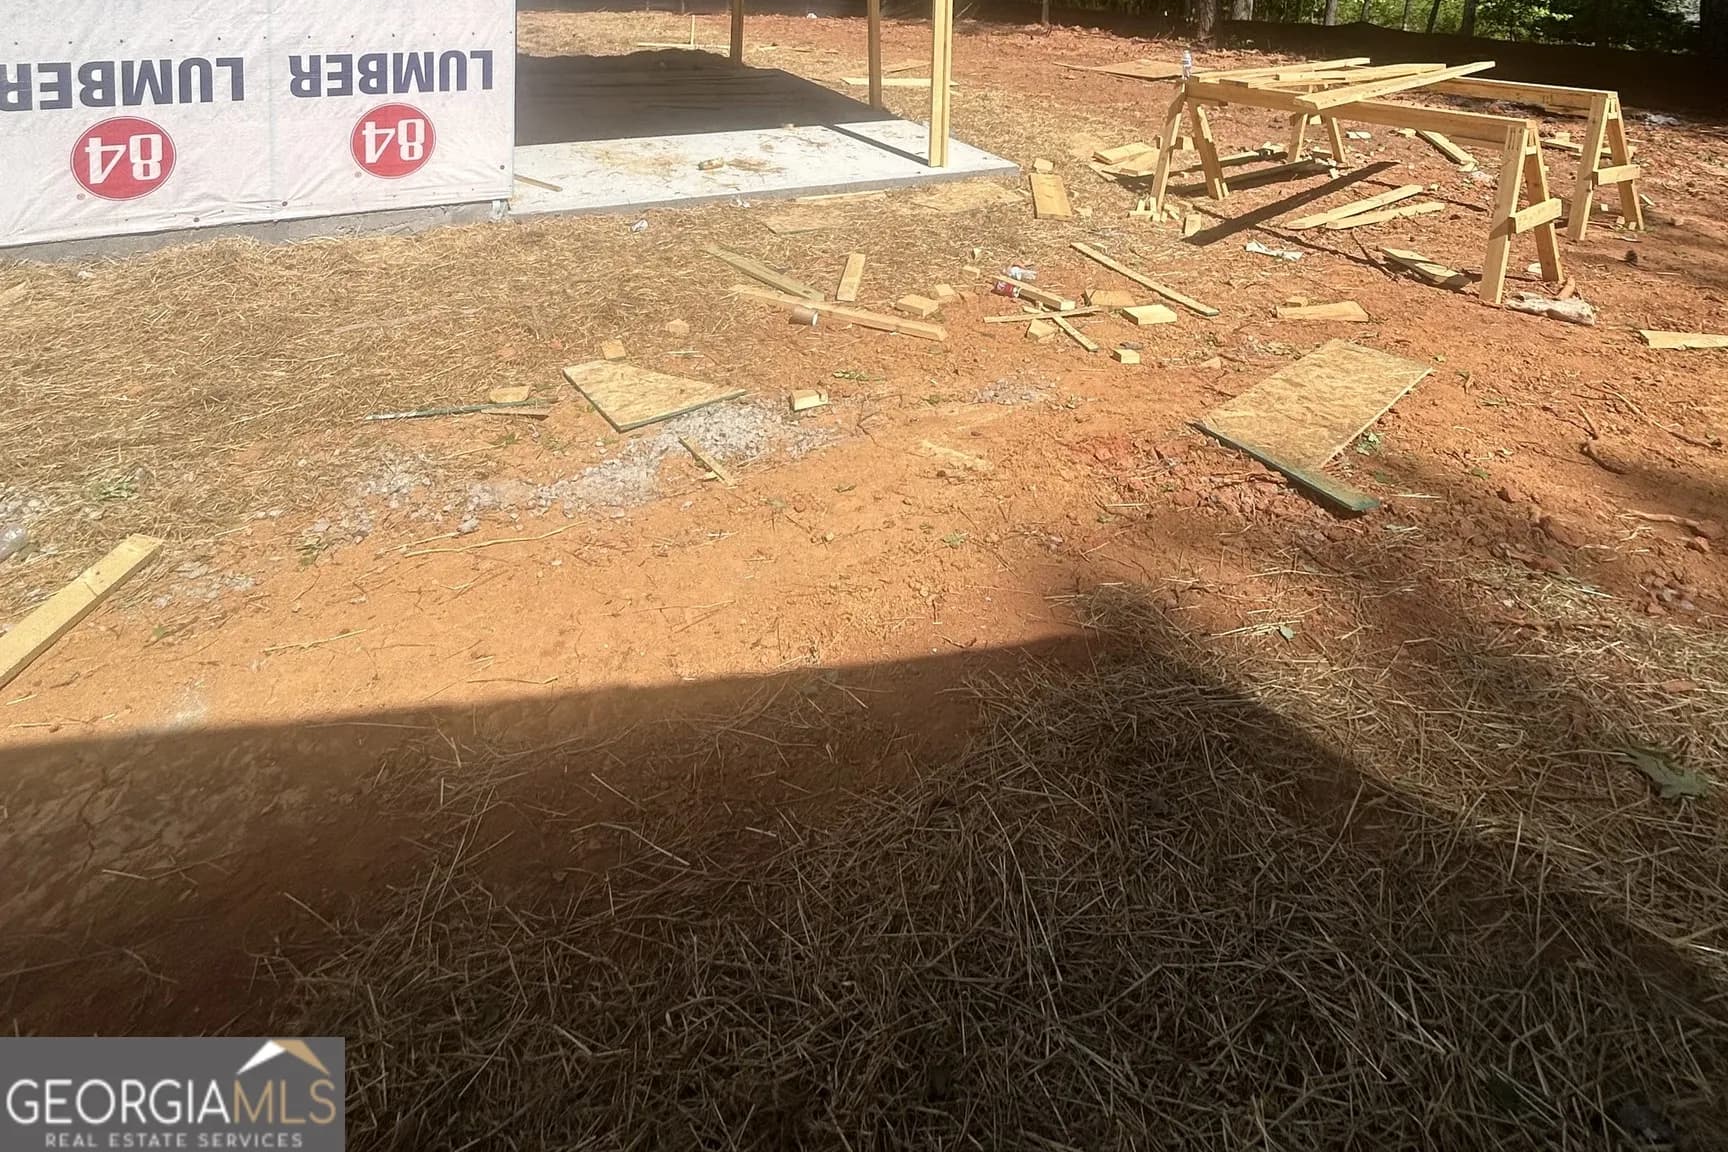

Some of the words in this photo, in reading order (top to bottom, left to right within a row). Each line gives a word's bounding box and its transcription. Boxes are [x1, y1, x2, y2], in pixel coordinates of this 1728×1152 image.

[0, 57, 244, 111] LUMBER
[289, 50, 493, 98] LUMBER
[85, 134, 163, 185] 84
[362, 119, 425, 164] 84
